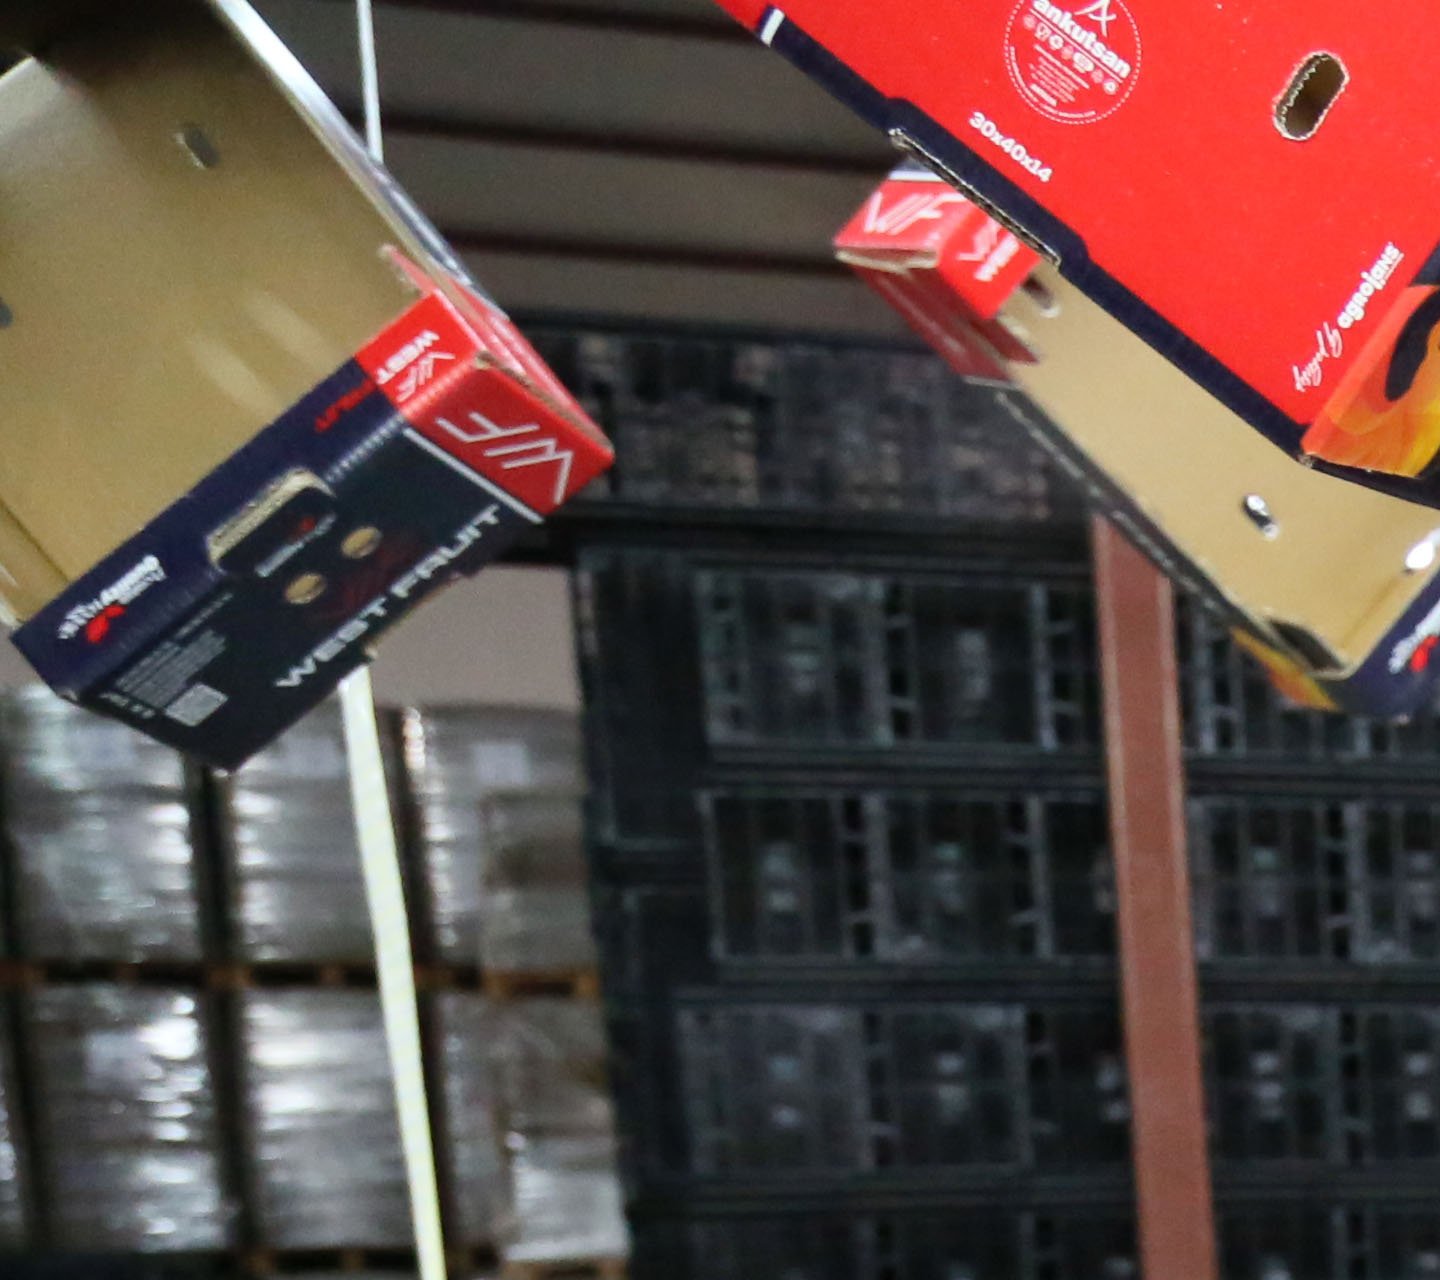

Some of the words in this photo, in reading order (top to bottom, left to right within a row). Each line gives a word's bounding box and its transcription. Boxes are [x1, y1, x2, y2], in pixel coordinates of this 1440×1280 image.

[1032, 0, 1133, 78] ankutsan
[968, 111, 1053, 182] 30x40x14
[435, 411, 574, 505] WF
[276, 597, 387, 688] WEST
[390, 503, 501, 599] FRUIT
